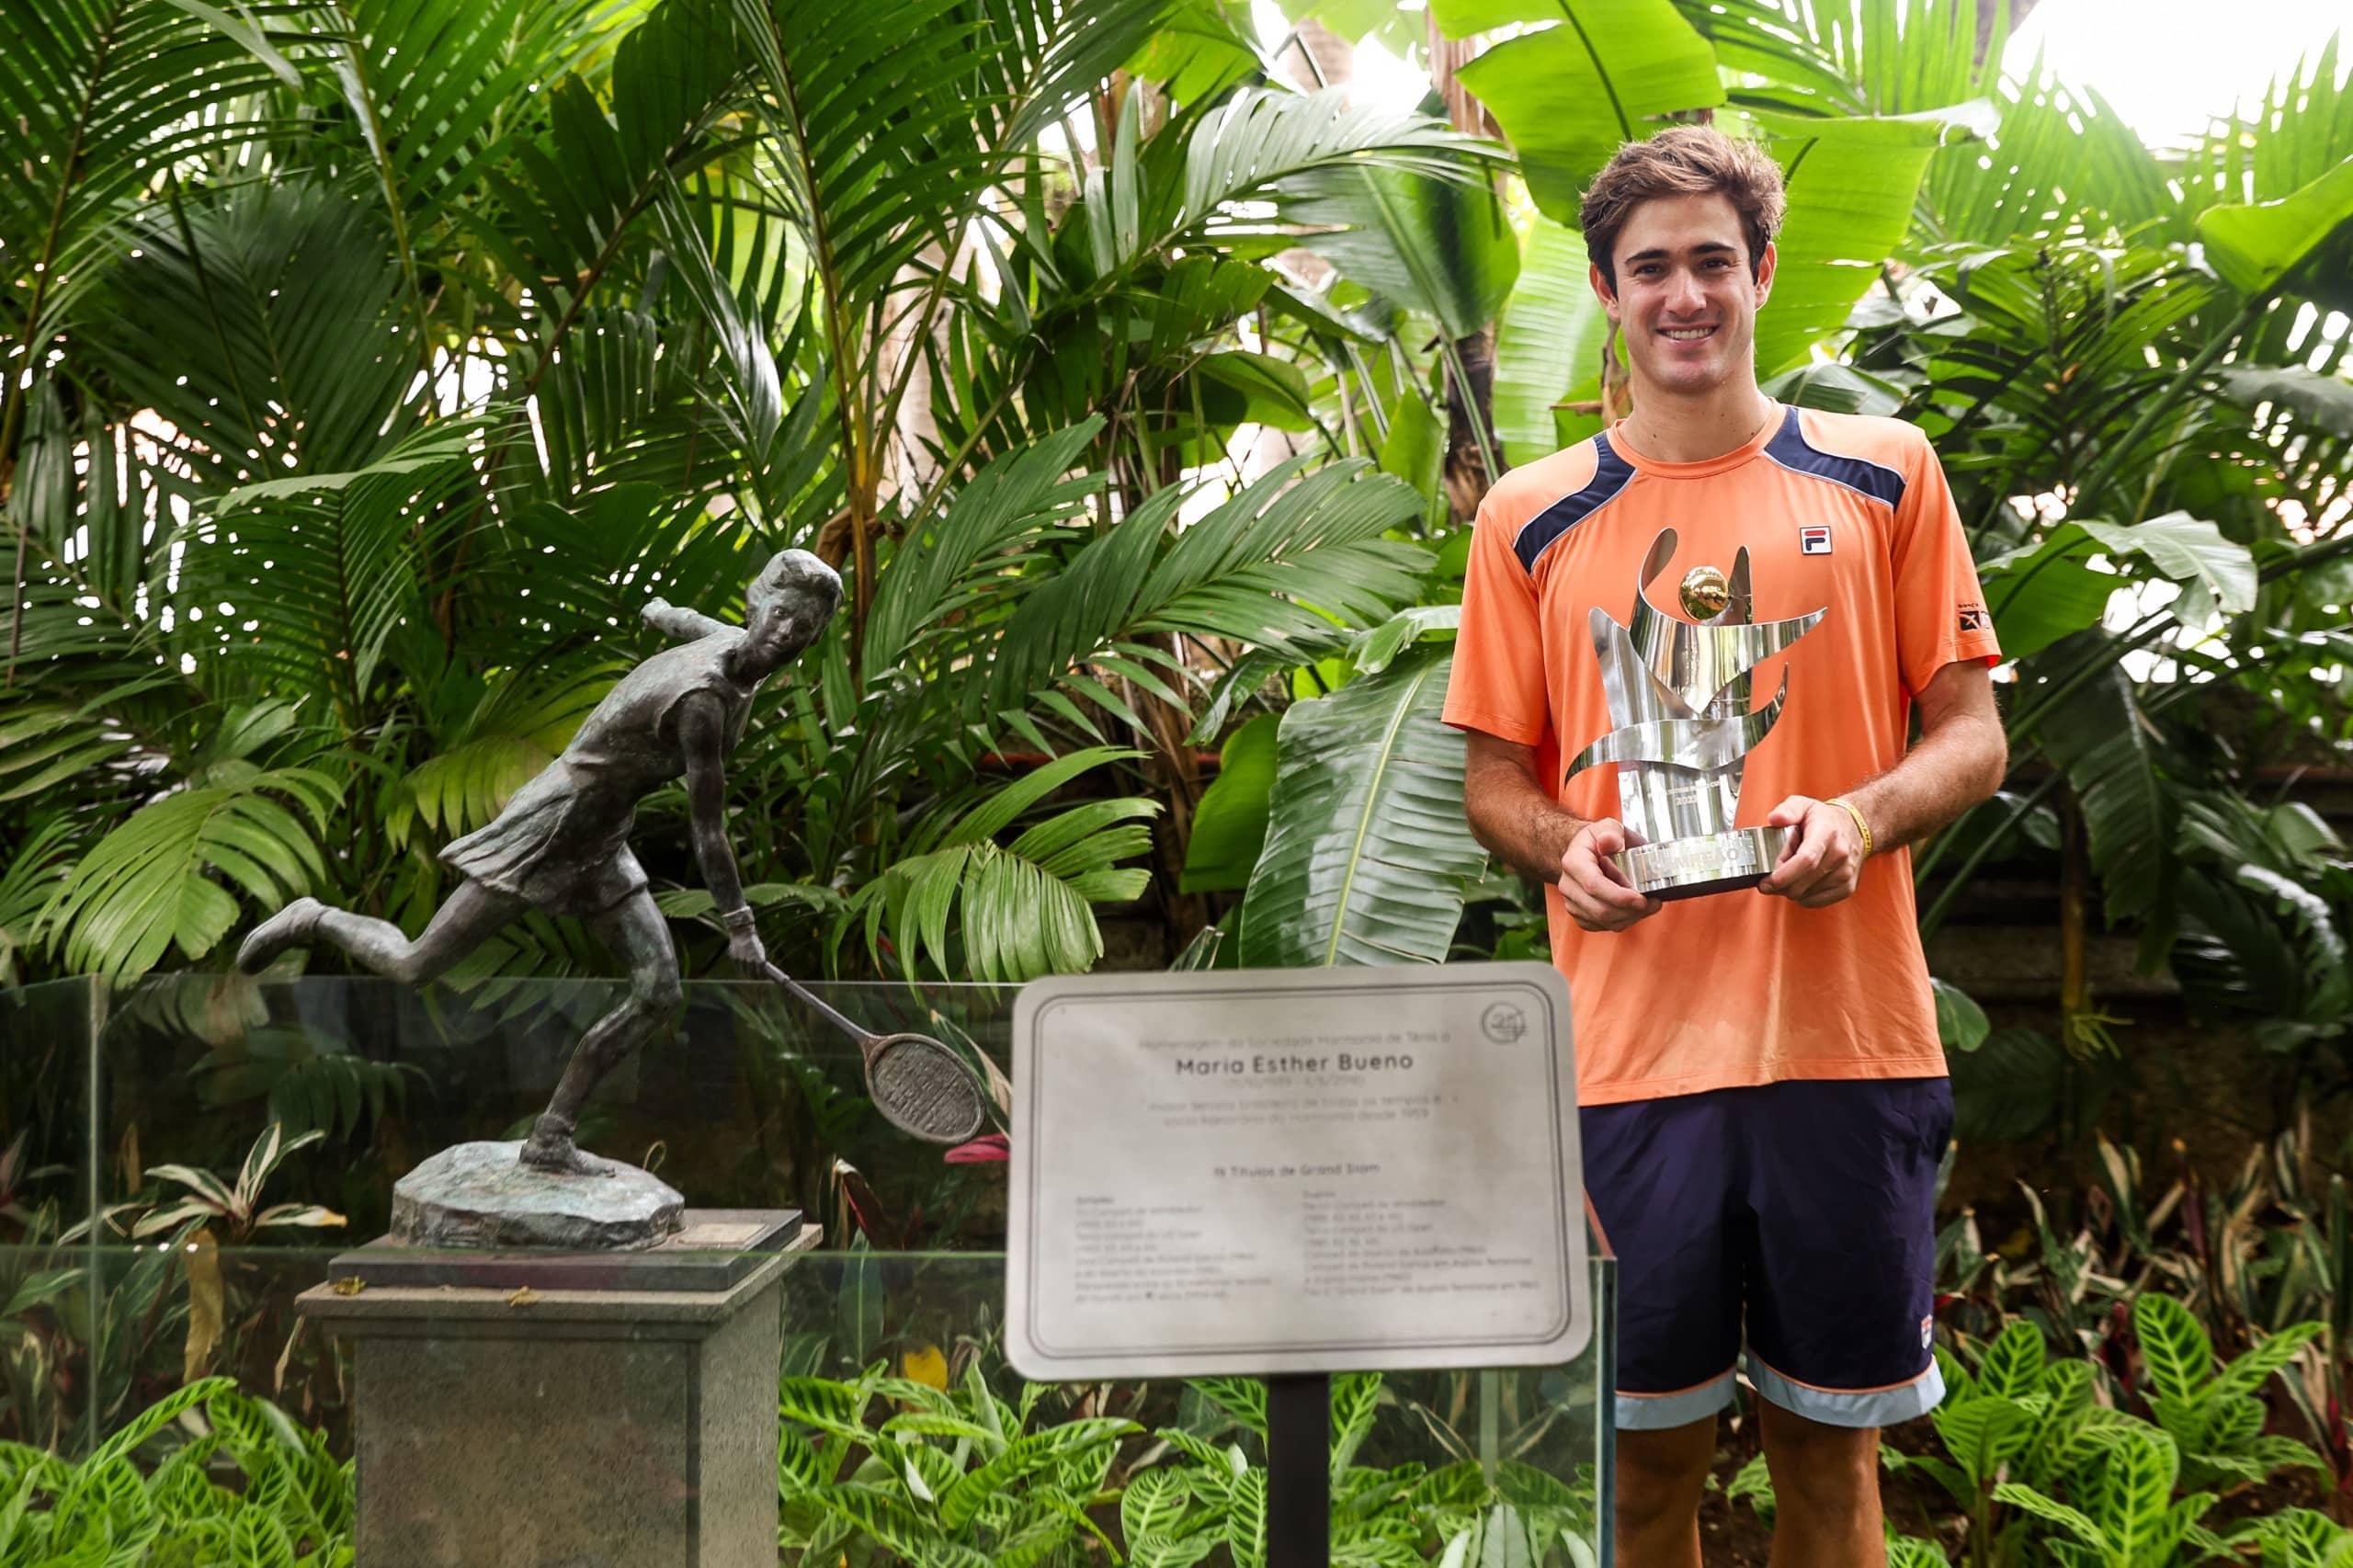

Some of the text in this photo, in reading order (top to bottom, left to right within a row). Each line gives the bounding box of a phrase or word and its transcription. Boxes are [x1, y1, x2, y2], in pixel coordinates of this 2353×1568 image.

[1175, 1052, 1414, 1075] Maria Esther Bueno
